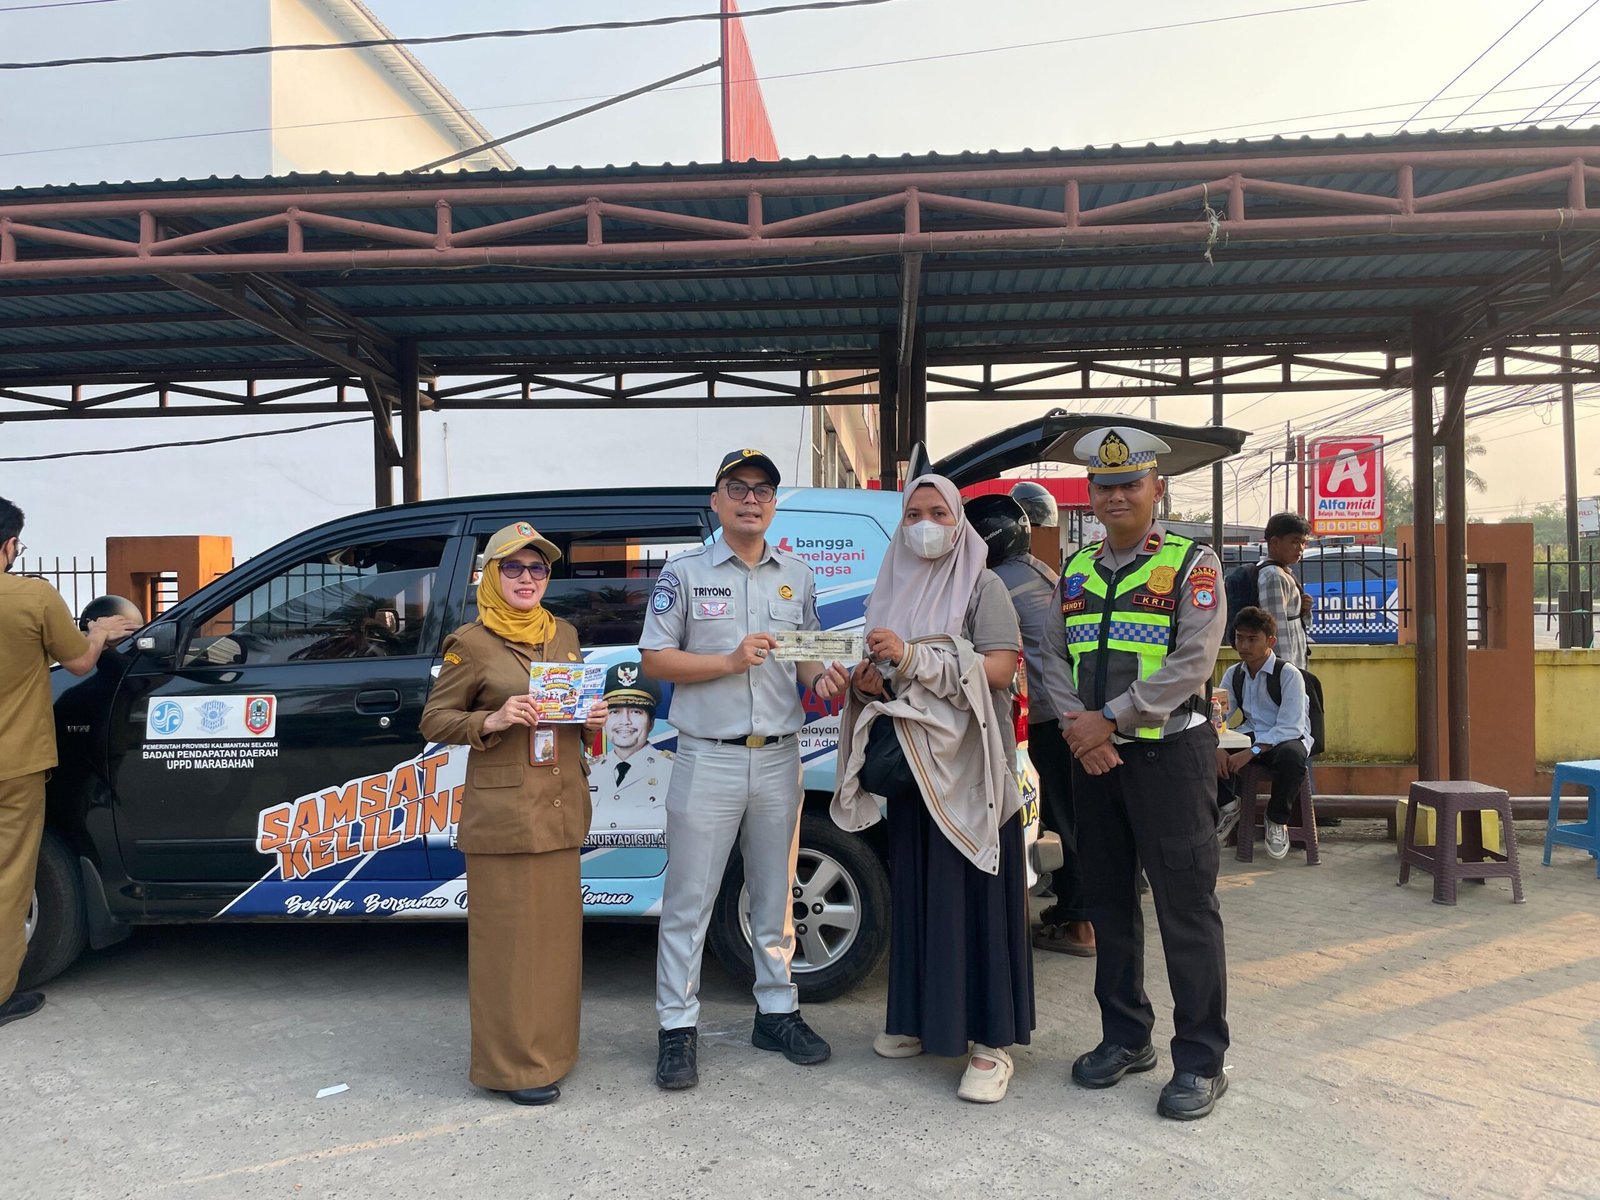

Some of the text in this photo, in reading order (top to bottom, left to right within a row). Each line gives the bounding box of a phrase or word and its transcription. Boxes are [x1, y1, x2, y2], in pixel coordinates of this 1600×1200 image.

[1318, 499, 1376, 510] Alfamidi
[796, 537, 853, 550] bangga
[815, 565, 851, 577] ngsa
[693, 587, 732, 597] TRIYONO
[1317, 596, 1376, 610] POLISI
[1344, 612, 1376, 620] LINTAS
[801, 726, 839, 737] elayan
[142, 749, 279, 759] BADAN PENDAPATAN DAERAH
[166, 759, 254, 769] UPPD MARABAHAN
[260, 752, 449, 851] SAMSAT
[584, 833, 634, 845] SNURYADI
[285, 895, 354, 915] Bekerja
[363, 893, 449, 913] Bersama
